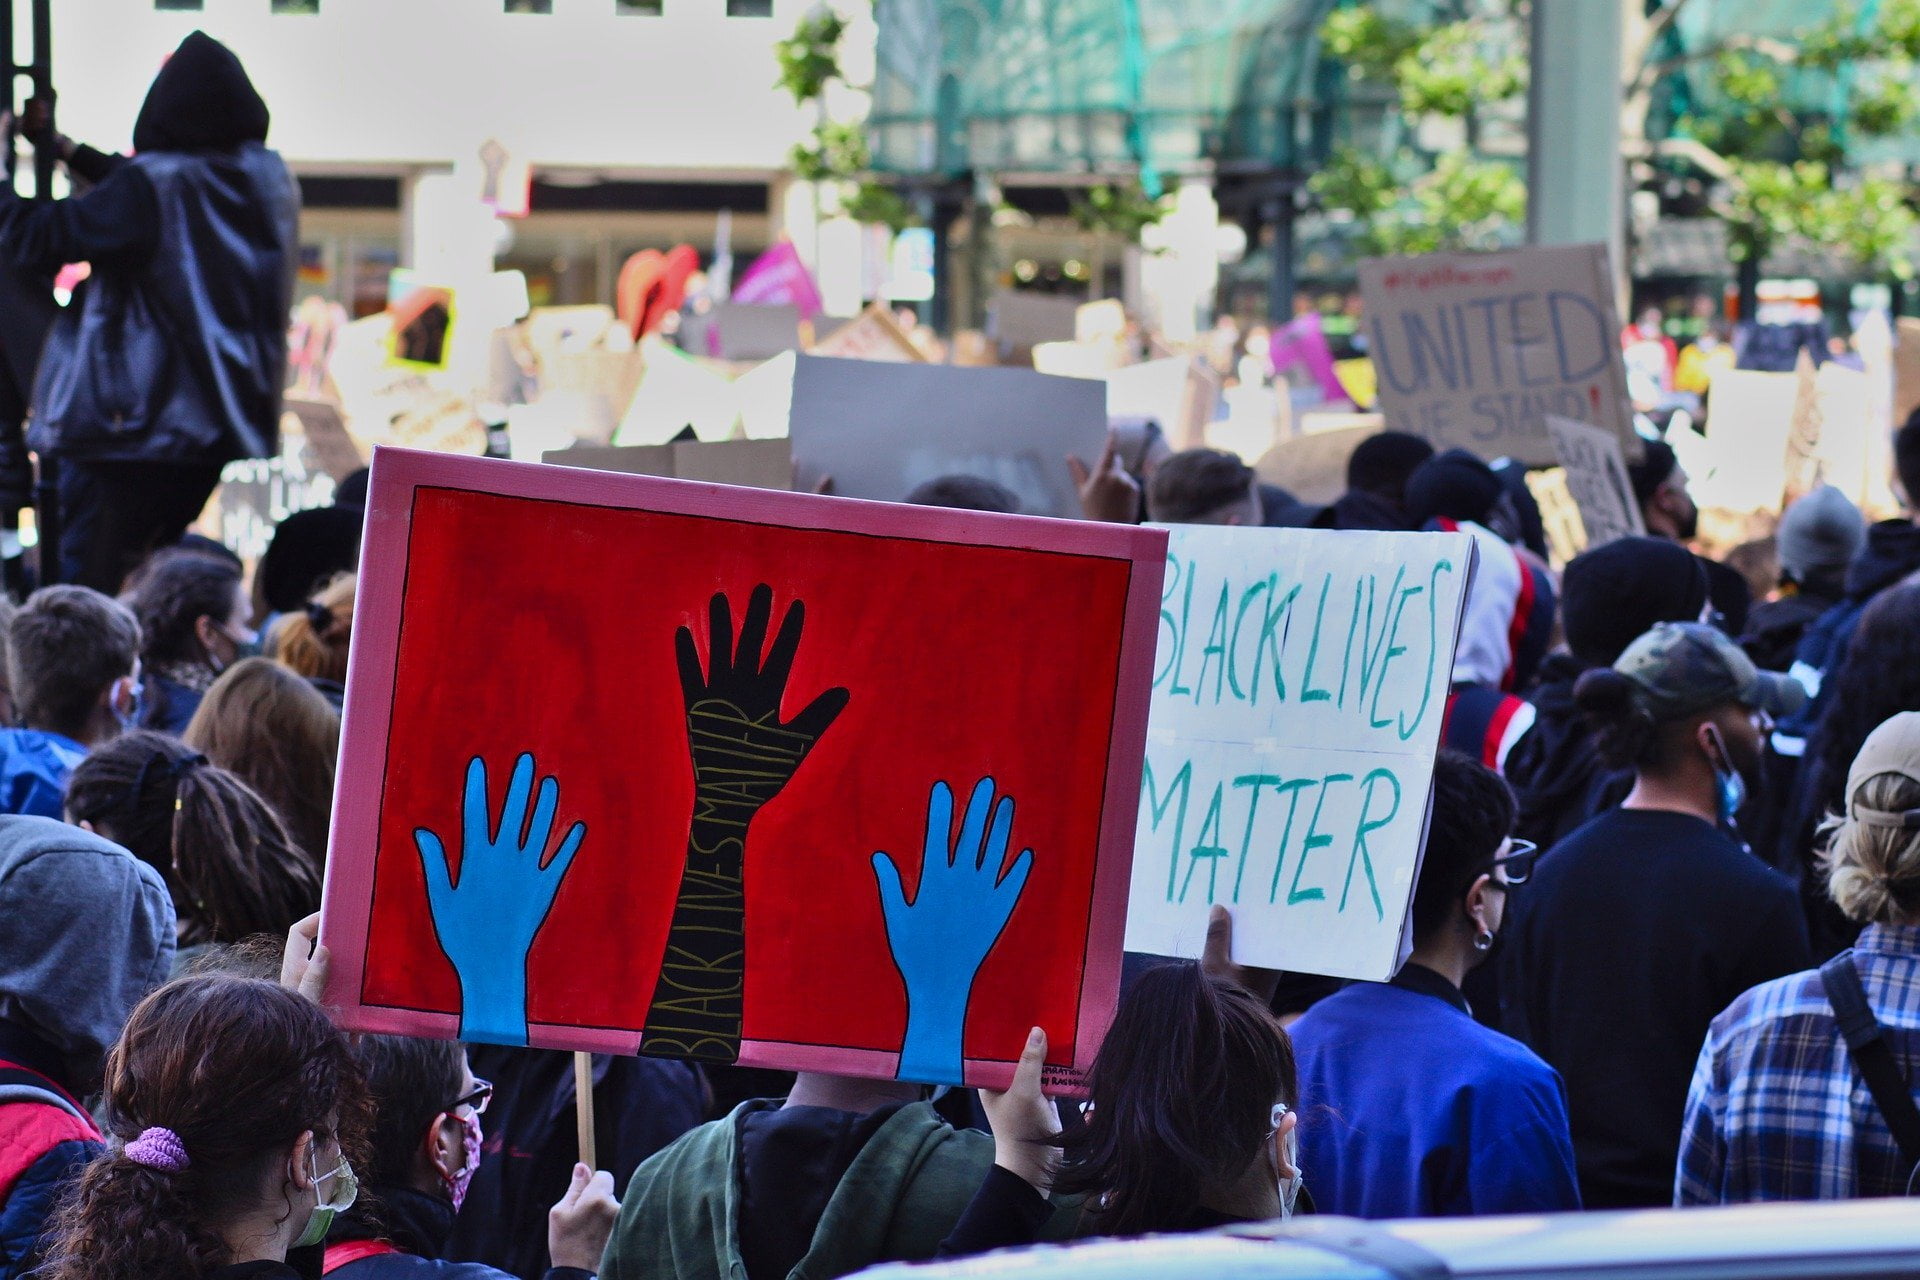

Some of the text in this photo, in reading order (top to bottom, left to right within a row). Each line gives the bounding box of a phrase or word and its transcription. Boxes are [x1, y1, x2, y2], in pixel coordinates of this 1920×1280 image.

[1371, 291, 1611, 396] UNITED
[1152, 552, 1452, 740] BLACK LIVES
[641, 699, 813, 1058] BLACK LIVES MATTER
[1142, 755, 1401, 921] MATTER
